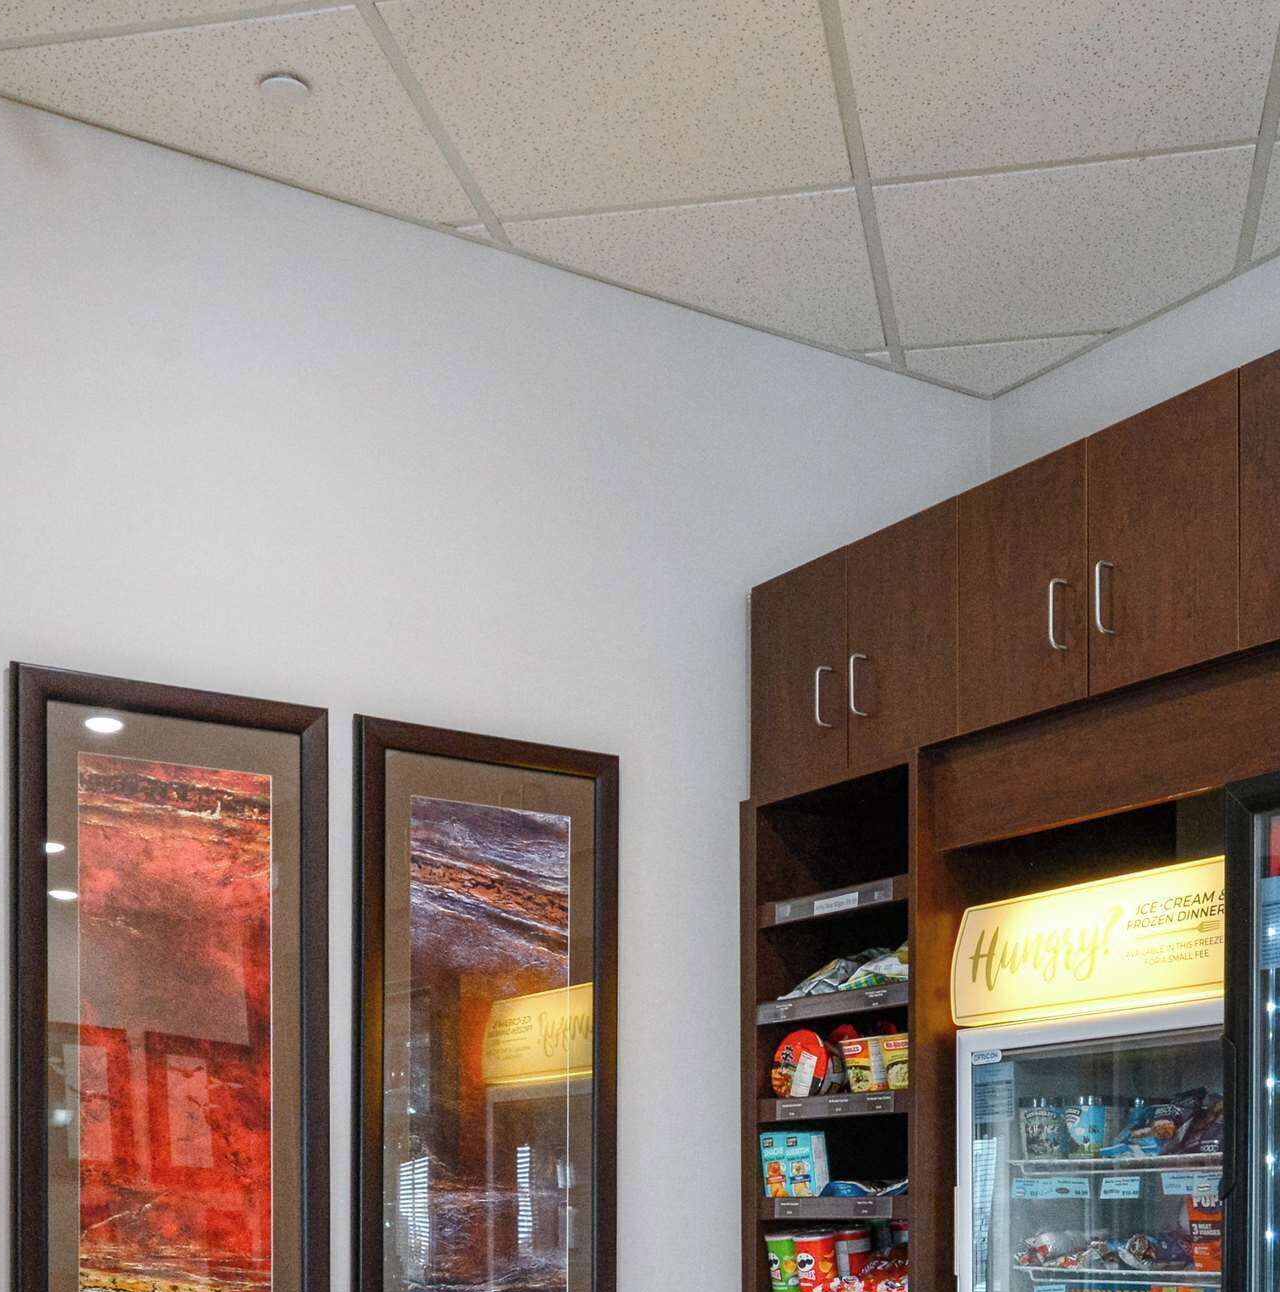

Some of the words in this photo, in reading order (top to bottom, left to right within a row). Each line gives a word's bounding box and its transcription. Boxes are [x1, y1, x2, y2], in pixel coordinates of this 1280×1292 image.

[1136, 890, 1216, 915] ICE-CREAM
[1126, 913, 1174, 931] FROZEN
[1169, 952, 1193, 961] SMALL
[1195, 949, 1209, 958] FEE
